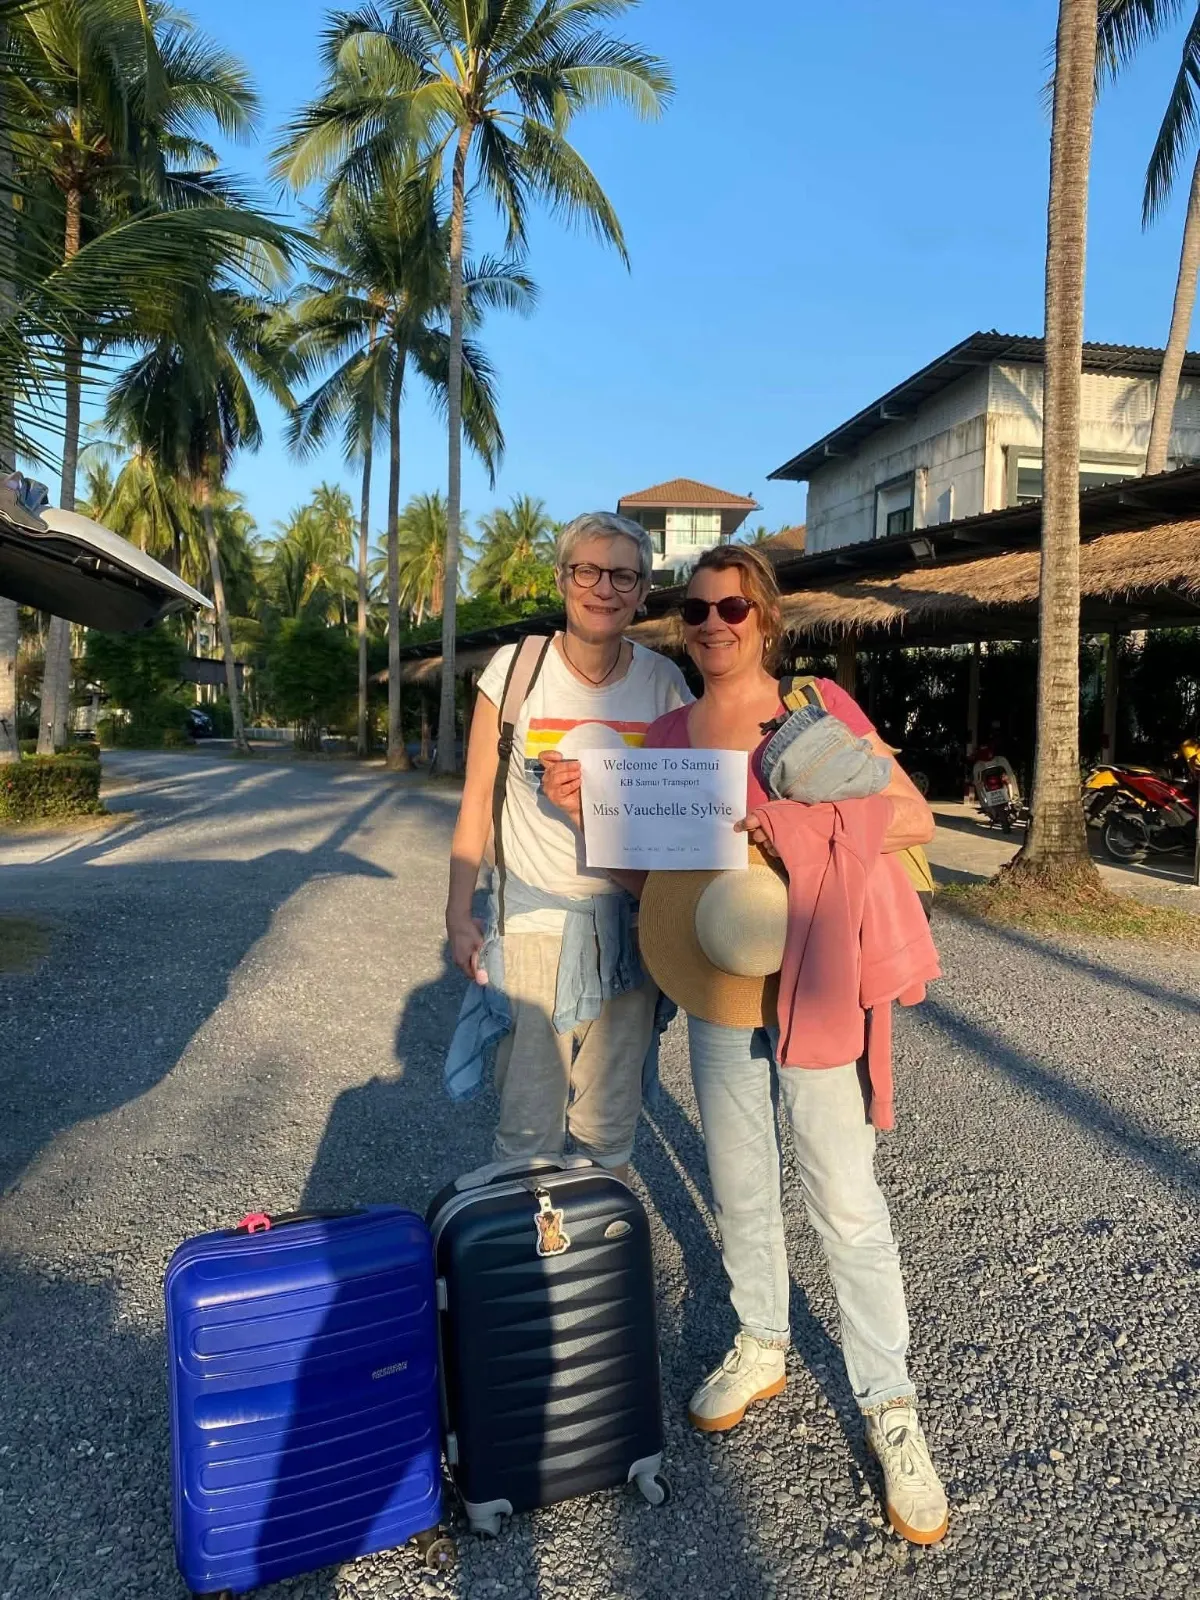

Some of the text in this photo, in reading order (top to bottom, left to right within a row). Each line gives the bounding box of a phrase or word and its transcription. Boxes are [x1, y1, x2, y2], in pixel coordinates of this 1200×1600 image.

[604, 758, 720, 771] Welcome To Samui
[620, 778, 700, 788] KB Samui Transport
[593, 802, 732, 818] Miss Vauchelle Sylvie
